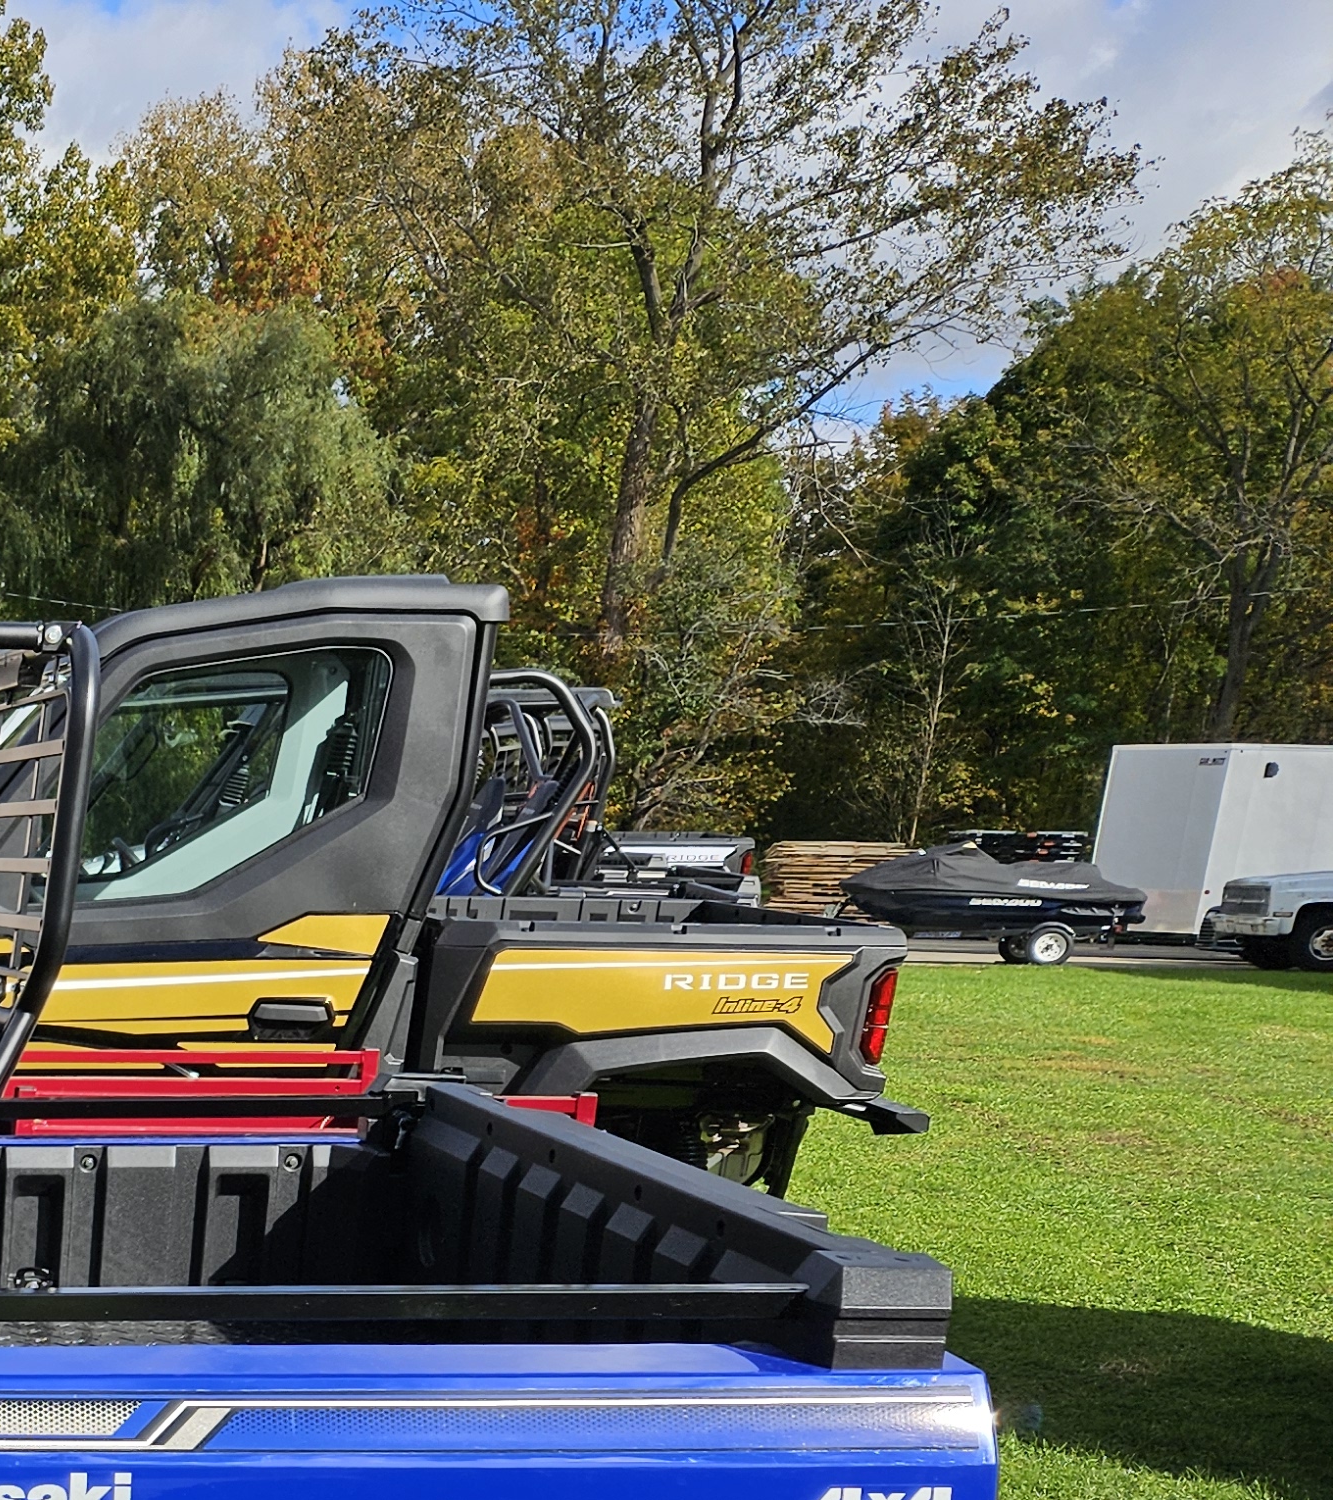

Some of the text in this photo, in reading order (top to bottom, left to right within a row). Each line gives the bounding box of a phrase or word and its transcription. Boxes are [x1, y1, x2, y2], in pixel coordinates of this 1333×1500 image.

[666, 854, 720, 862] RIDGE
[663, 972, 810, 991] RIDGE
[711, 995, 804, 1015] Inline-4
